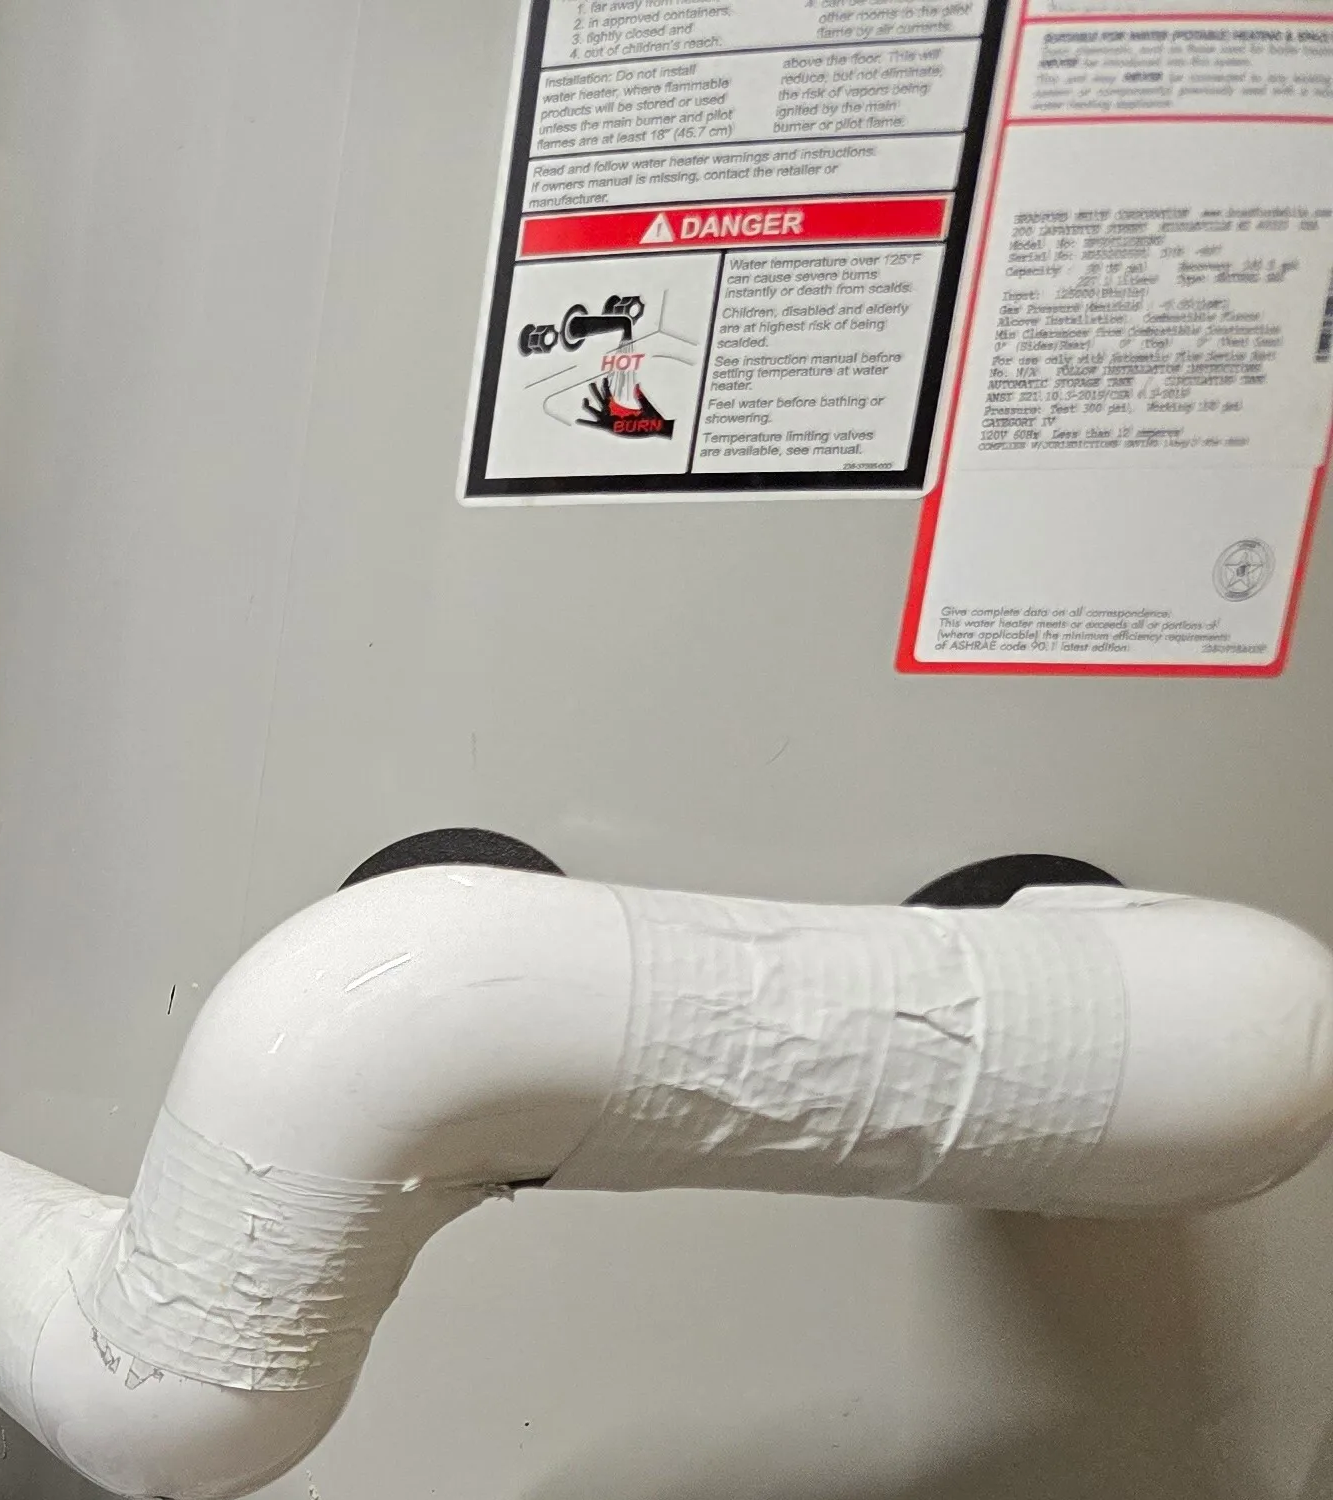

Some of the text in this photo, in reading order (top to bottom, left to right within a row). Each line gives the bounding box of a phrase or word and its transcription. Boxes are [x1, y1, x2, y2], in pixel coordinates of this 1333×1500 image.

[681, 212, 805, 239] DANGER
[729, 259, 767, 270] Water
[770, 257, 847, 269] temperature
[851, 256, 879, 266] over
[727, 274, 750, 284] can
[754, 274, 792, 283] cause
[795, 272, 837, 281] severe
[725, 282, 911, 300] instantly or death from scalds.
[723, 302, 909, 319] Children, disabled and elderly
[720, 319, 884, 334] are at highest risk of being
[717, 337, 769, 349] scalded.
[601, 354, 645, 371] HOT
[714, 351, 902, 367] See instruction manual before
[613, 420, 662, 432] BURN
[703, 430, 873, 444] Temperature limiting valves
[700, 444, 862, 458] are available, see manual.
